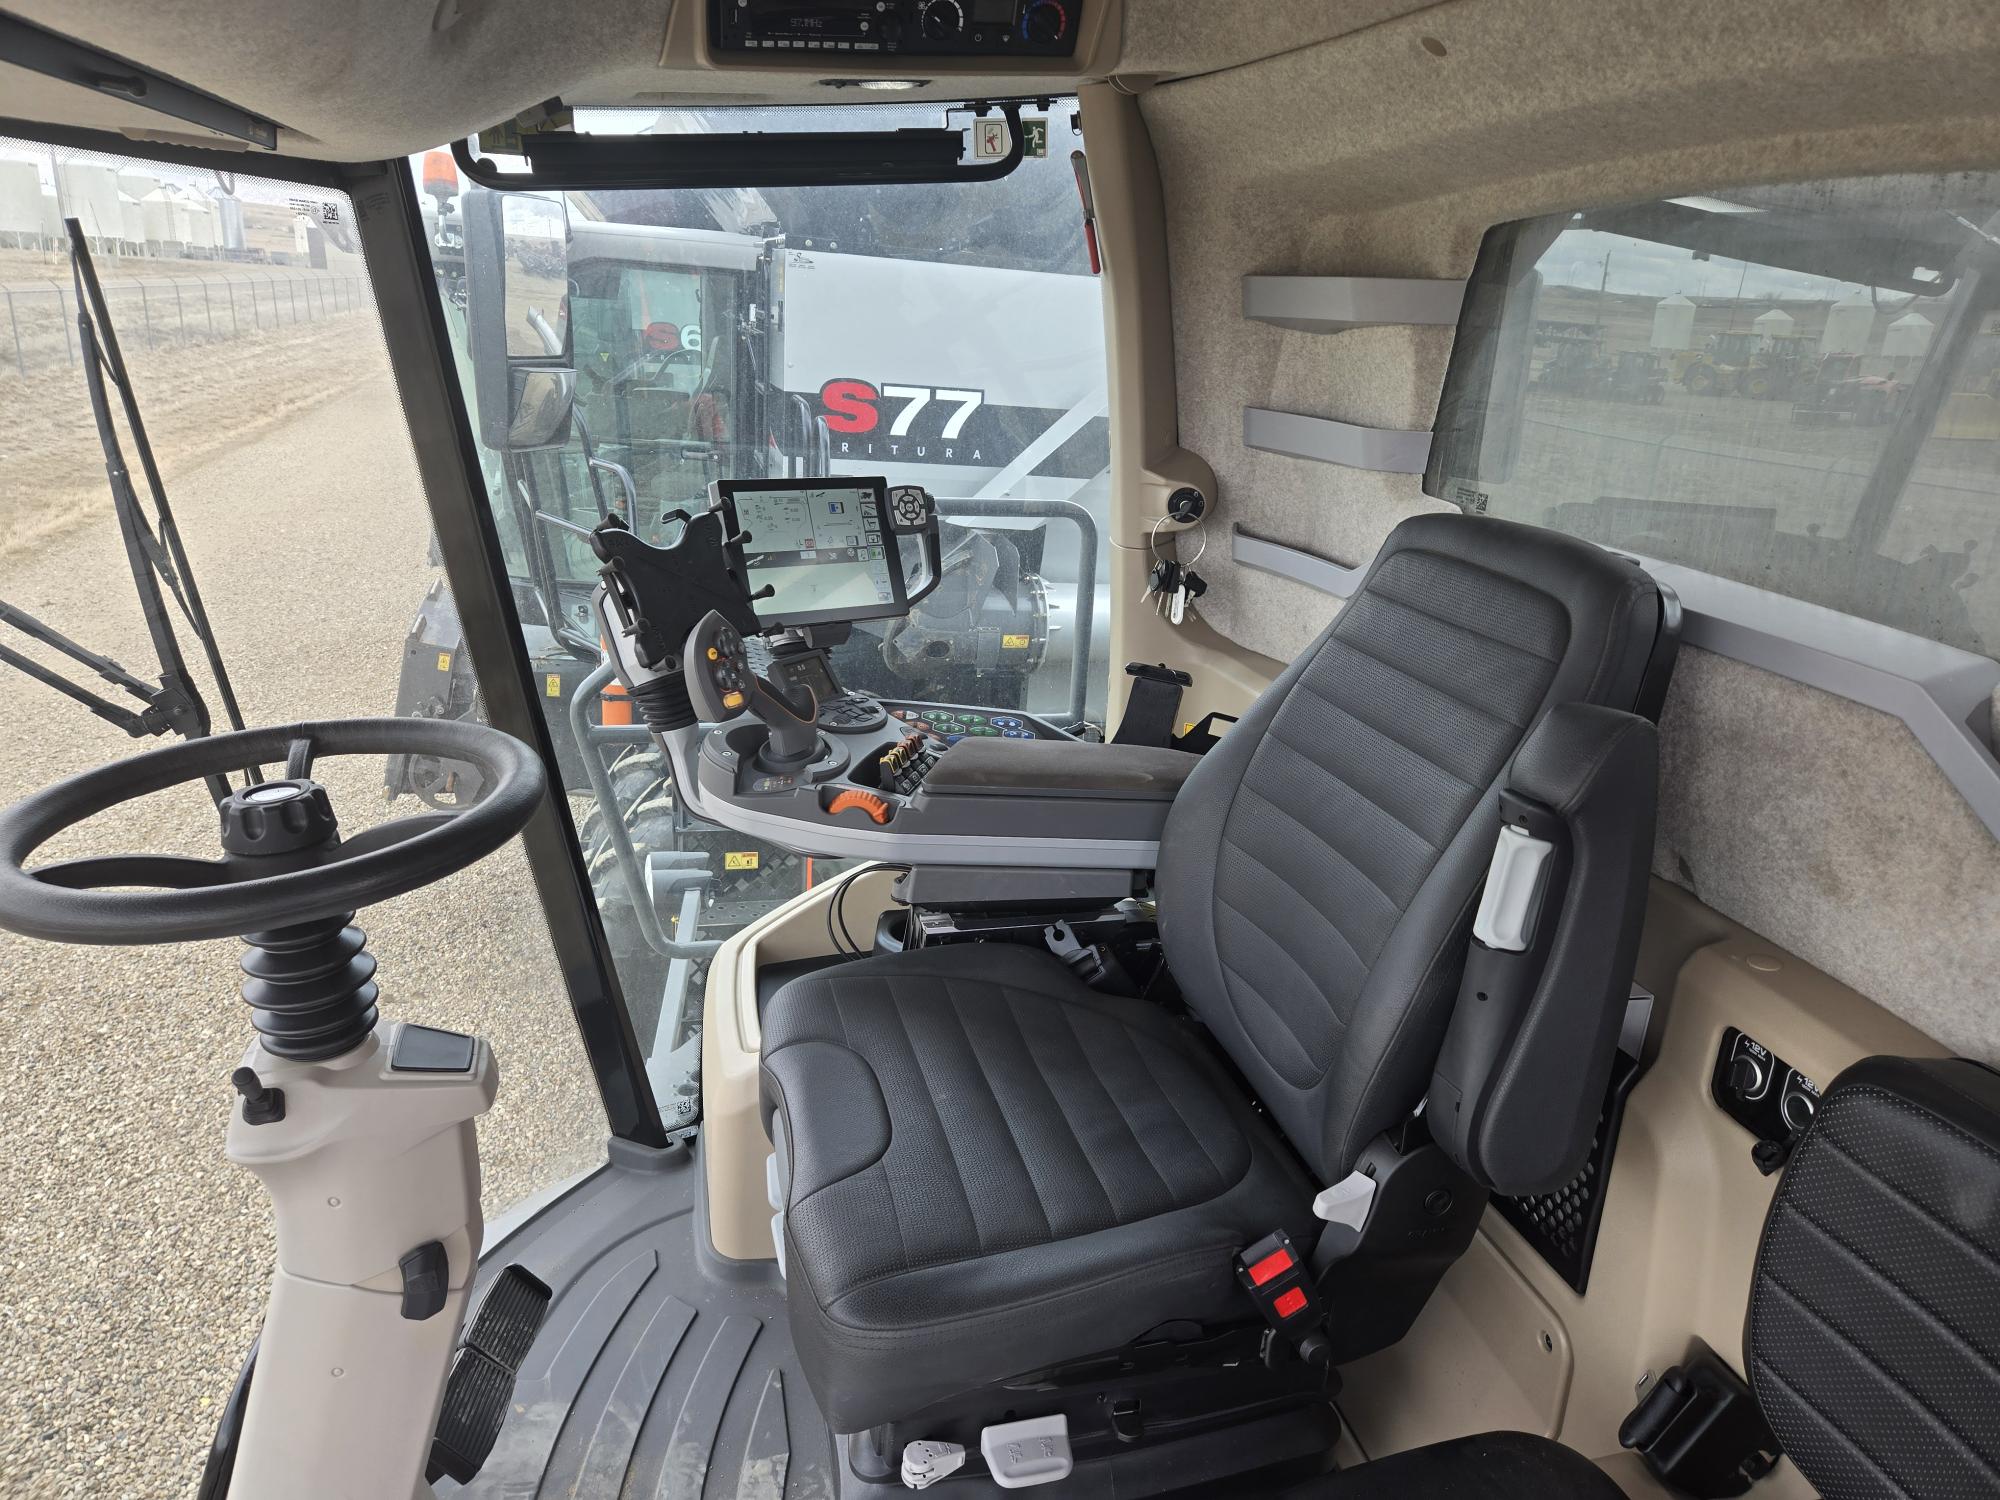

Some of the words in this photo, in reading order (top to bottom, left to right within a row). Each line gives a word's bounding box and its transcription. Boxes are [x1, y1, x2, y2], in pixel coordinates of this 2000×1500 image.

[645, 322, 702, 352] S6
[821, 379, 984, 440] S77
[840, 442, 982, 460] RITURA
[1750, 1042, 1767, 1056] 12V
